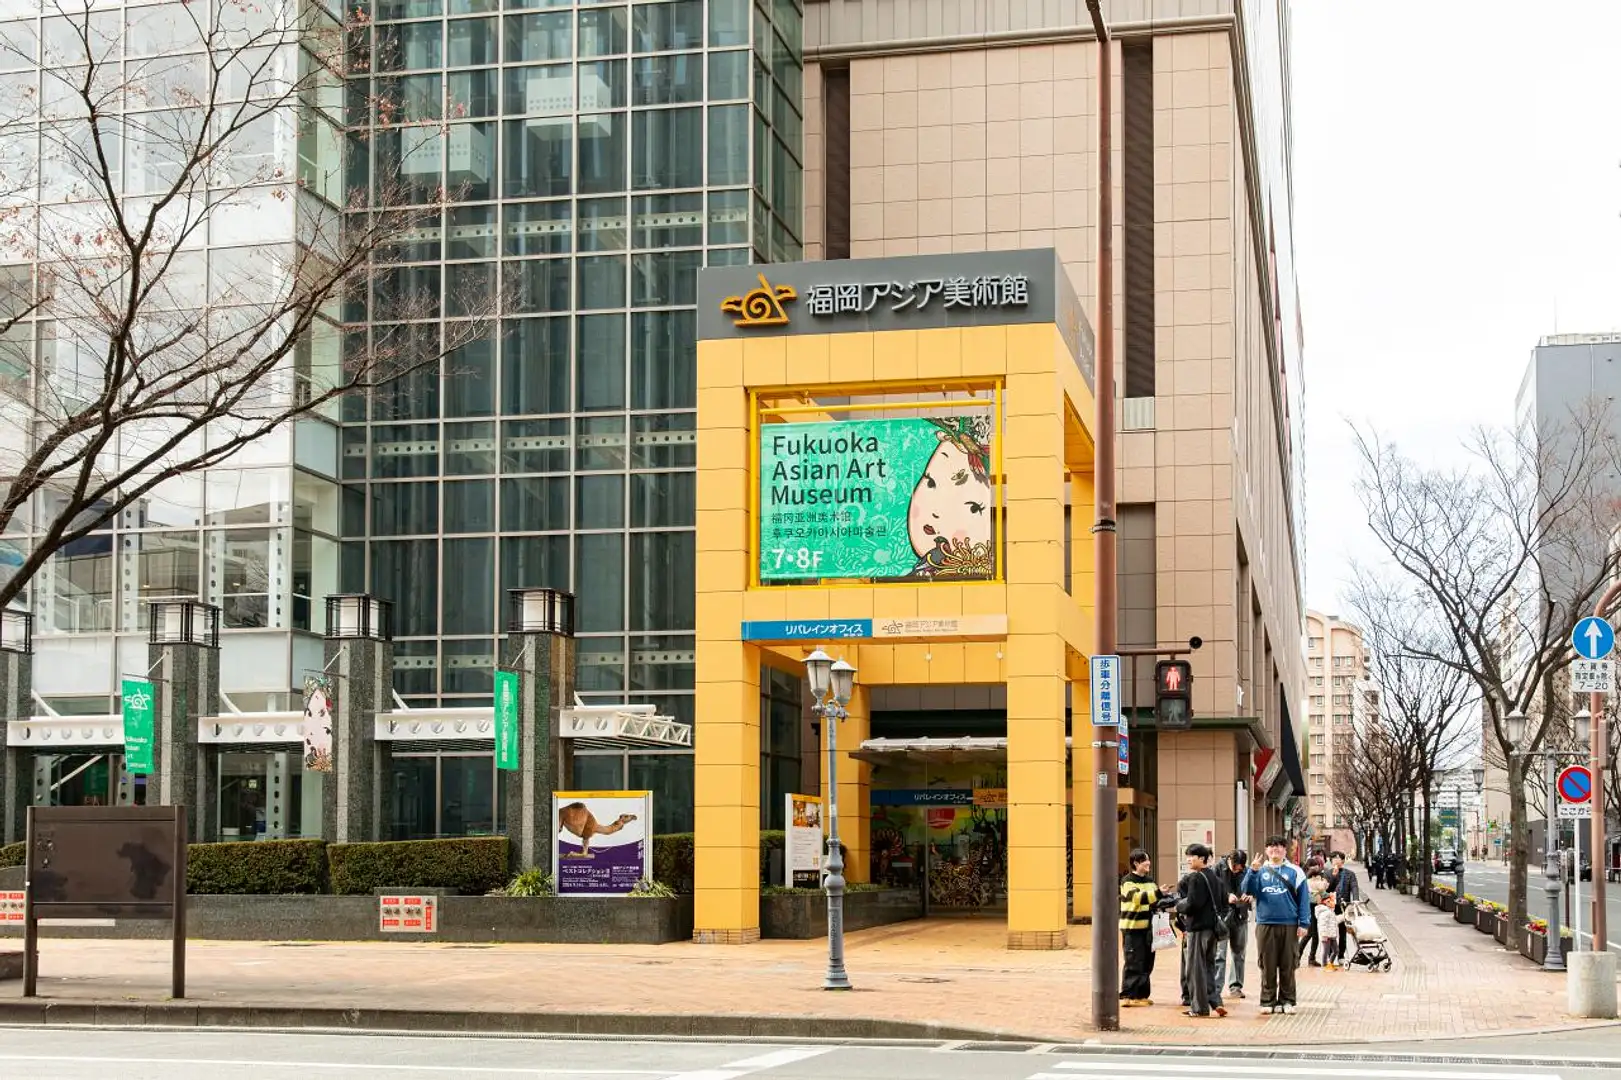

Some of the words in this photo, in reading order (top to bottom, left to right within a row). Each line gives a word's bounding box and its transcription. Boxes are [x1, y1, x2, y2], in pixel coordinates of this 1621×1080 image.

[805, 273, 1029, 315] 福岡アジア美術館
[772, 431, 879, 456] Fukuoka
[772, 460, 840, 481] Asian
[847, 458, 886, 479] Art
[771, 485, 873, 505] Museum
[772, 525, 887, 540] 후쿠오카아시아미술관
[1100, 660, 1111, 722] 歩車分離信号
